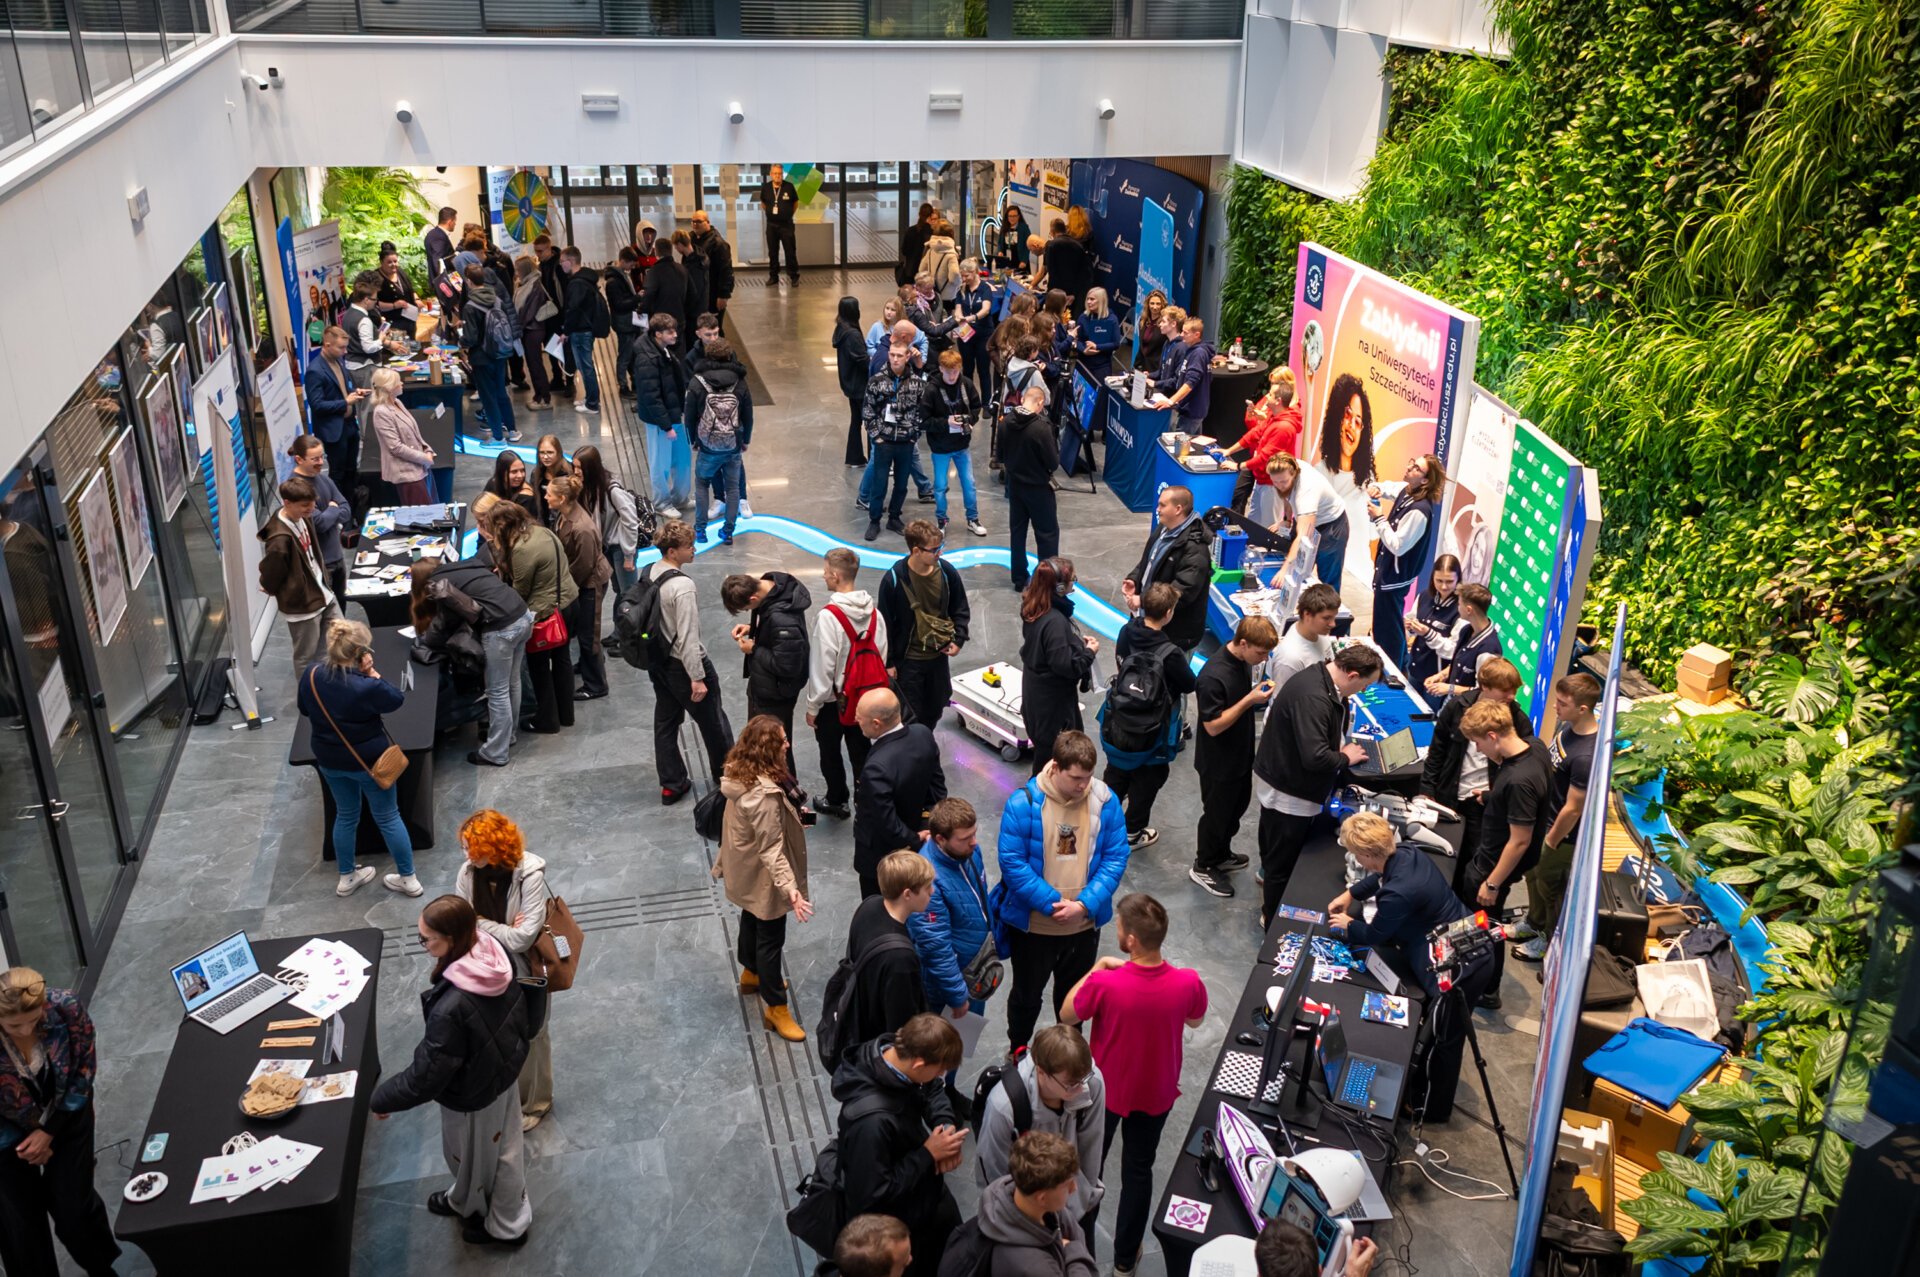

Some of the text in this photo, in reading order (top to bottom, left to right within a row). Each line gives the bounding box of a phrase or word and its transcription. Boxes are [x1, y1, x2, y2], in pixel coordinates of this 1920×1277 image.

[1358, 339, 1436, 391] na Uniwersytecie
[1361, 298, 1440, 370] Zabłyśnij
[1369, 366, 1433, 414] Szczecińskim!
[1438, 337, 1457, 463] ndydaci.usz.edu.pl
